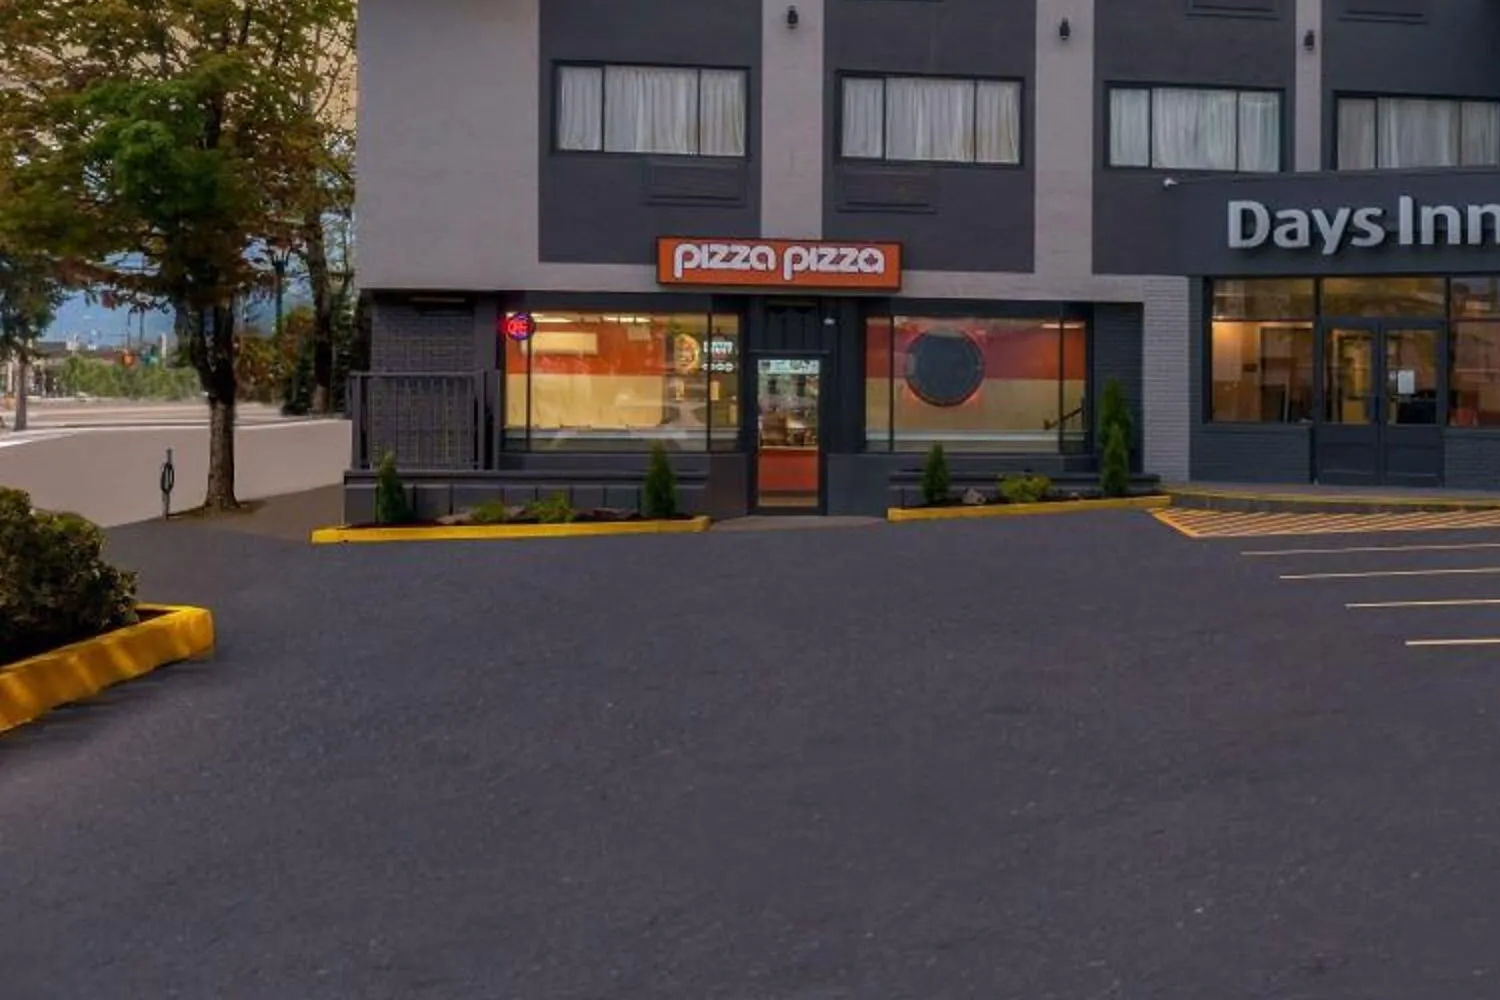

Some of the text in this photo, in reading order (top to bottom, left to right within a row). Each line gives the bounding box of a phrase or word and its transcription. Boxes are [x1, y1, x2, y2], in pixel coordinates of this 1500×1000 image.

[1227, 199, 1386, 256] Days
[673, 243, 885, 281] pizza pizza
